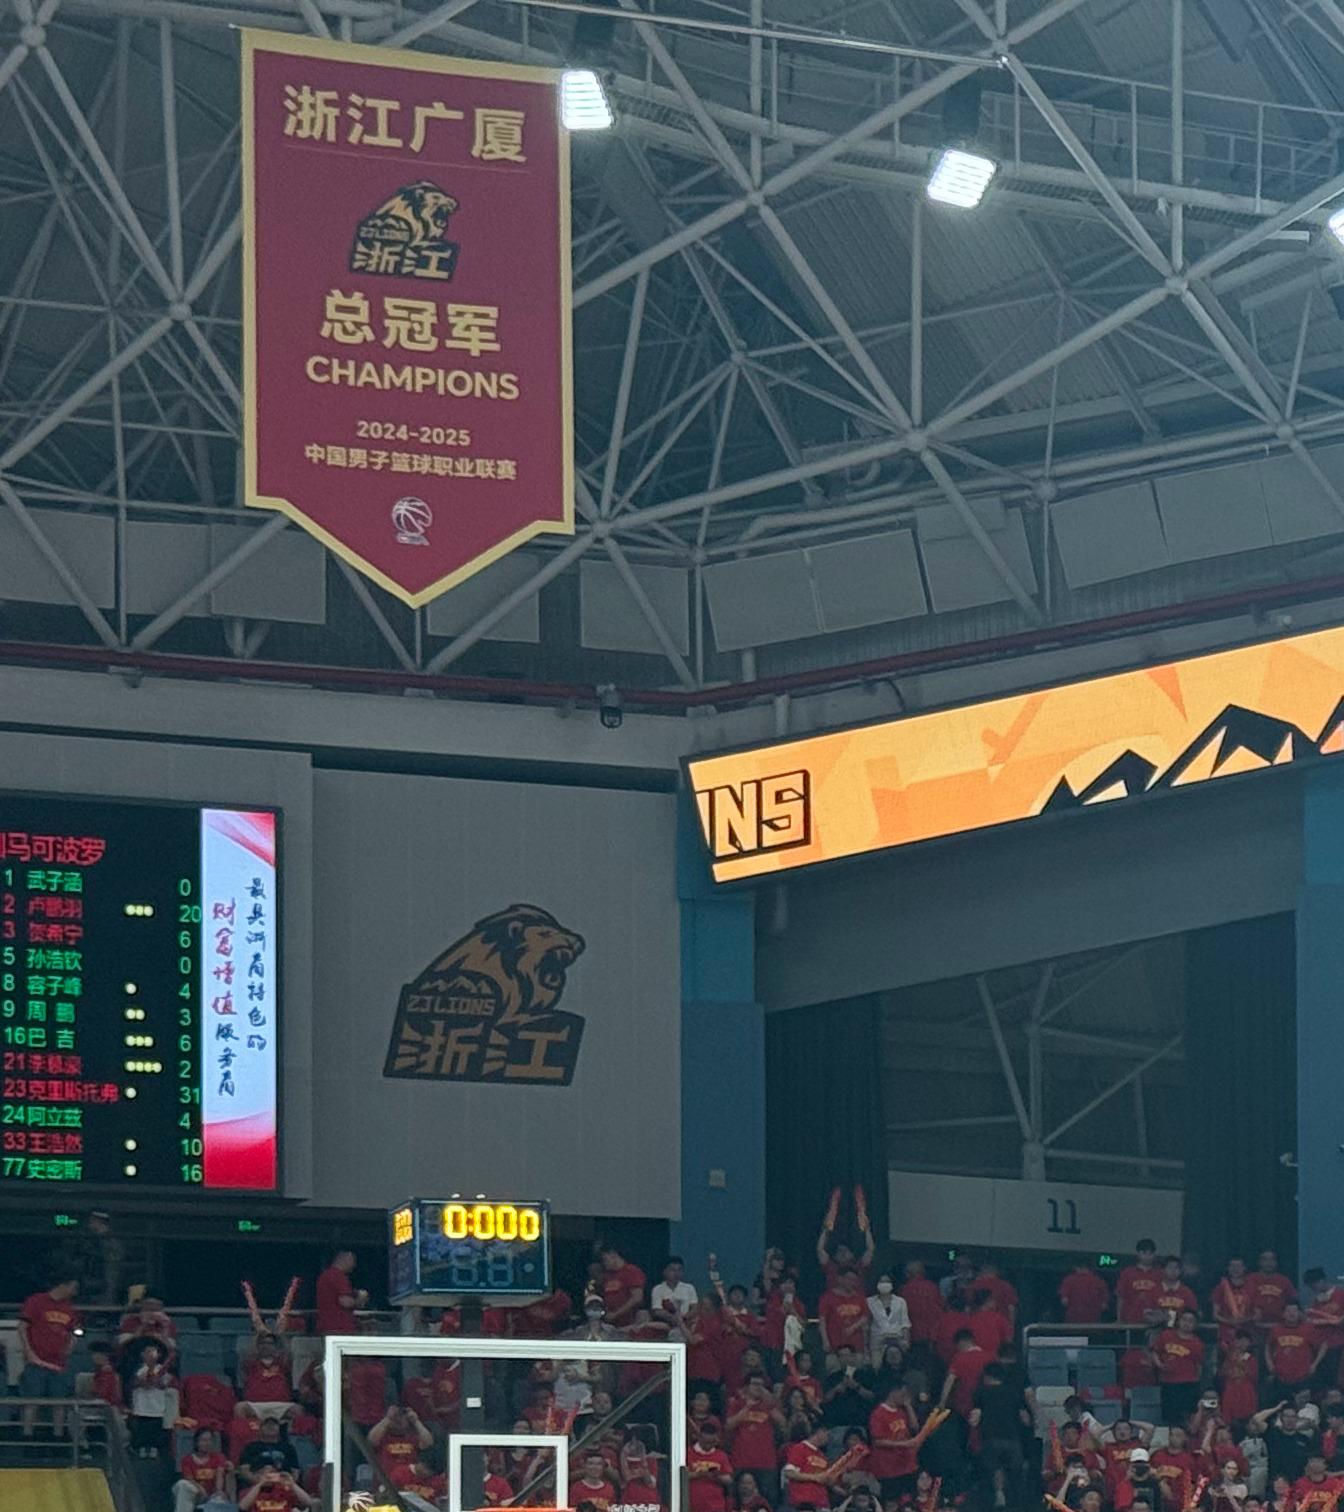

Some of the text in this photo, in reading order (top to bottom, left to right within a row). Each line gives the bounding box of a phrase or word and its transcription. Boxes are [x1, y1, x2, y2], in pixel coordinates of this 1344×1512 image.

[282, 84, 527, 164] 浙江广厦
[352, 241, 452, 279] 浙江
[320, 290, 501, 356] 总冠军
[306, 355, 519, 399] CHAMPIONS
[357, 421, 471, 446] 2024-2025
[304, 444, 517, 480] 中国男子篮球职业联赛
[5, 869, 13, 886] 1
[179, 879, 191, 896] 0
[3, 893, 15, 914] 2
[179, 905, 201, 923] 20
[3, 921, 16, 939] 3
[179, 931, 191, 949] 6
[3, 947, 16, 965] 5
[179, 957, 191, 974] 0
[3, 974, 15, 992] 8
[179, 983, 191, 1000] 4
[3, 1000, 15, 1018] 9
[179, 1009, 191, 1026] 3
[4, 1027, 27, 1045] 16
[179, 1034, 191, 1052] 6
[394, 1020, 569, 1079] 浙江
[4, 1053, 25, 1071] 21
[179, 1061, 191, 1078] 2
[4, 1079, 27, 1097] 23
[179, 1087, 200, 1104] 31
[2, 1105, 25, 1124] 24
[179, 1112, 191, 1129] 4
[4, 1132, 27, 1150] 33
[180, 1138, 202, 1156] 10
[2, 1157, 26, 1176] 77
[180, 1164, 202, 1182] 16
[1046, 1198, 1081, 1234] 11
